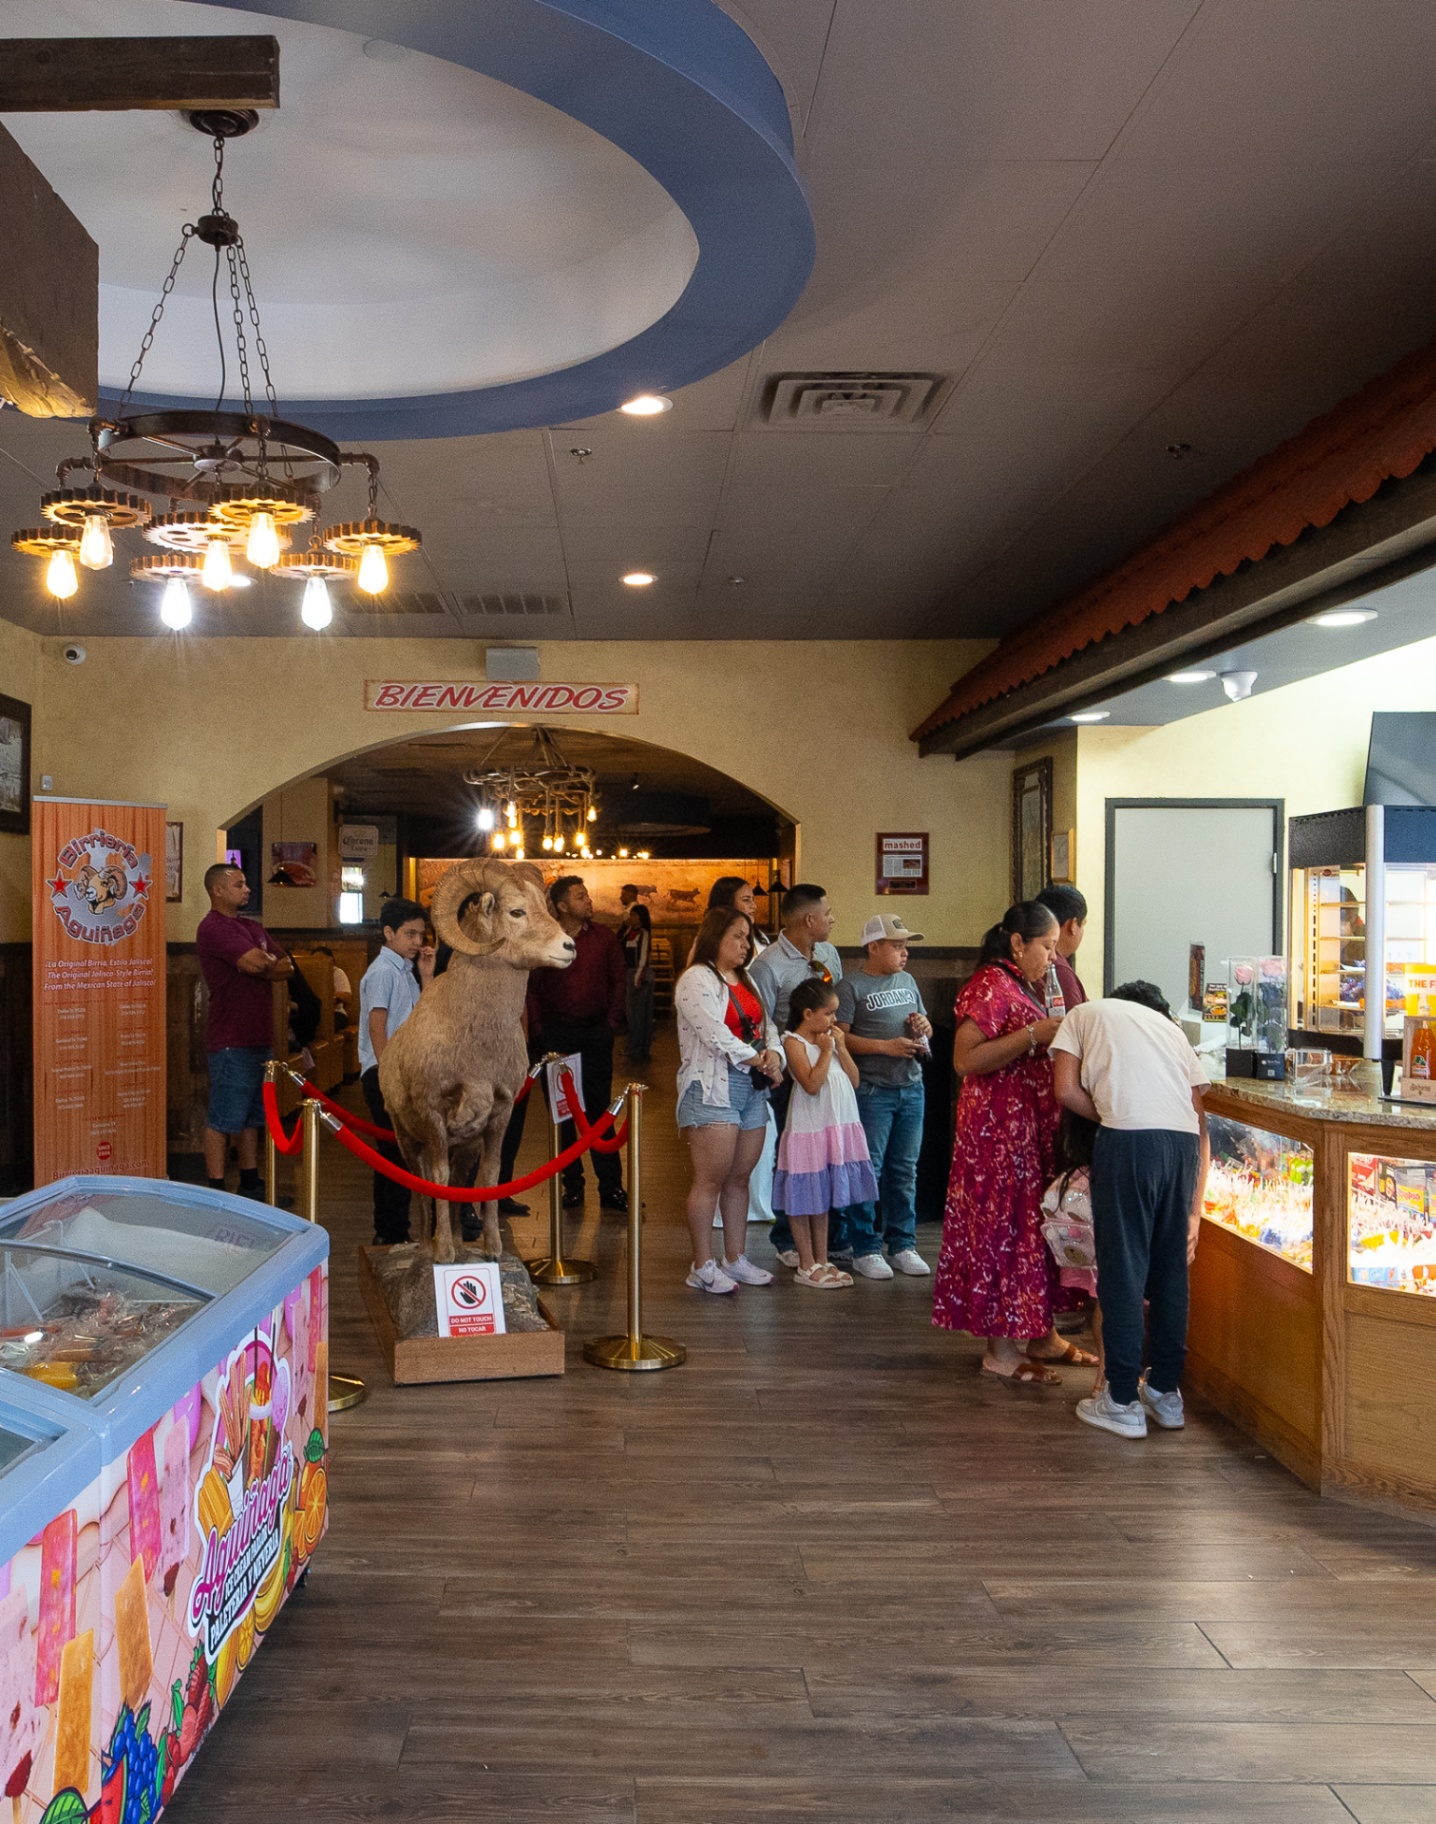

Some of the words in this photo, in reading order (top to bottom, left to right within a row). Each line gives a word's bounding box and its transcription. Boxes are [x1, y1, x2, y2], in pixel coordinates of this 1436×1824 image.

[374, 684, 630, 710] BIENVENIDOS
[884, 841, 921, 849] mashed
[55, 903, 145, 942] Aguiñaga
[58, 960, 87, 969] Original
[48, 971, 60, 979] The
[62, 971, 91, 980] Original
[64, 981, 76, 989] the
[77, 981, 105, 989] Mexican
[106, 980, 124, 988] State
[1408, 979, 1428, 988] THE
[866, 988, 909, 1011] JORDAN
[192, 1455, 288, 1620] Aguiñaga
